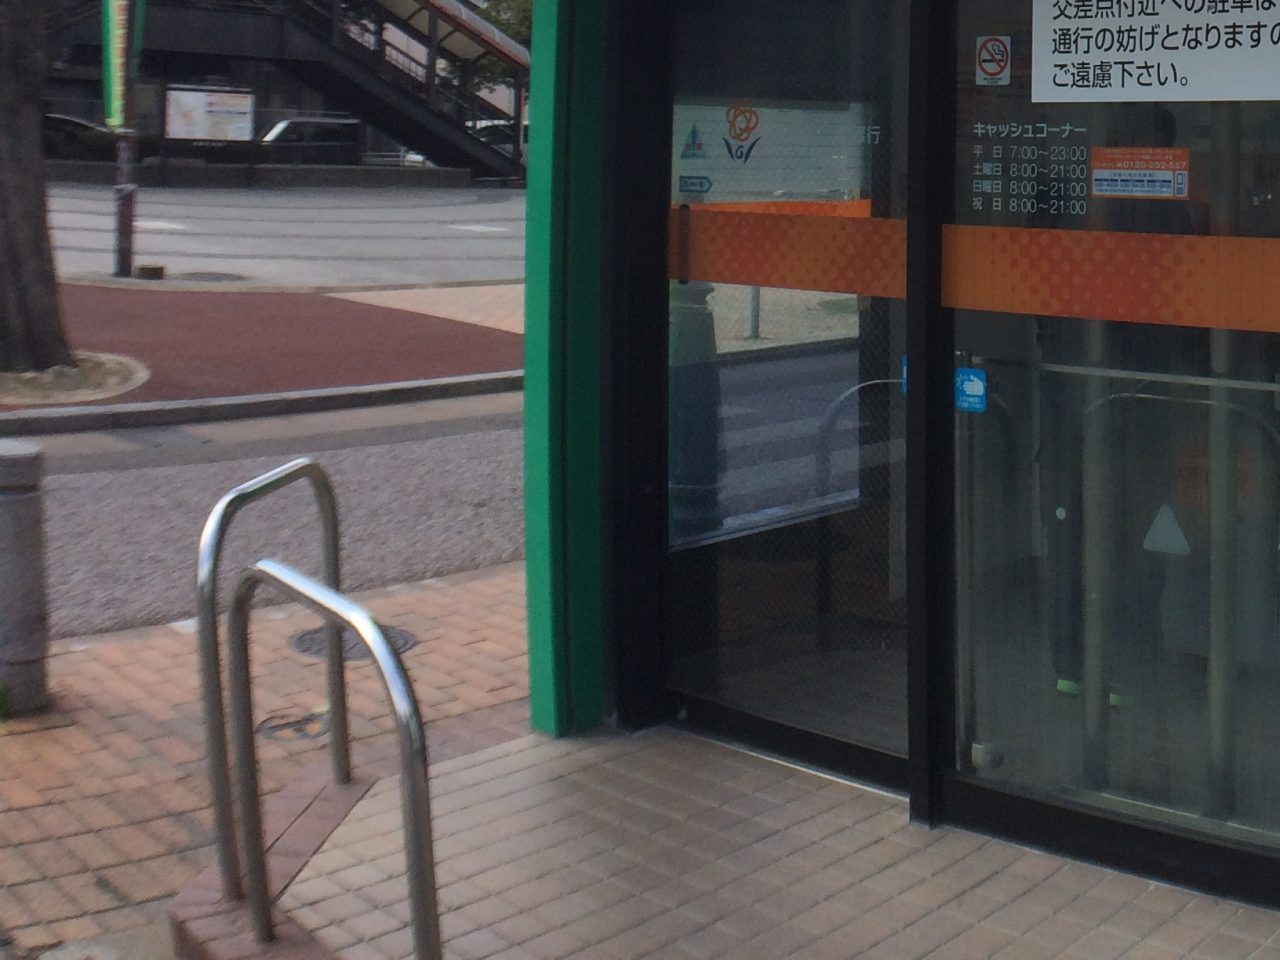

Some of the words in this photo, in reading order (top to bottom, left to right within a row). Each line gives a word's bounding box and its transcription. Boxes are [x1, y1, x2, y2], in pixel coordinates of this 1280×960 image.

[1052, 60, 1188, 89] ご遠慮下さい。
[973, 121, 1087, 138] キャッシュコーナー
[973, 162, 1002, 175] 土曜日
[973, 180, 1002, 193] 日曜日
